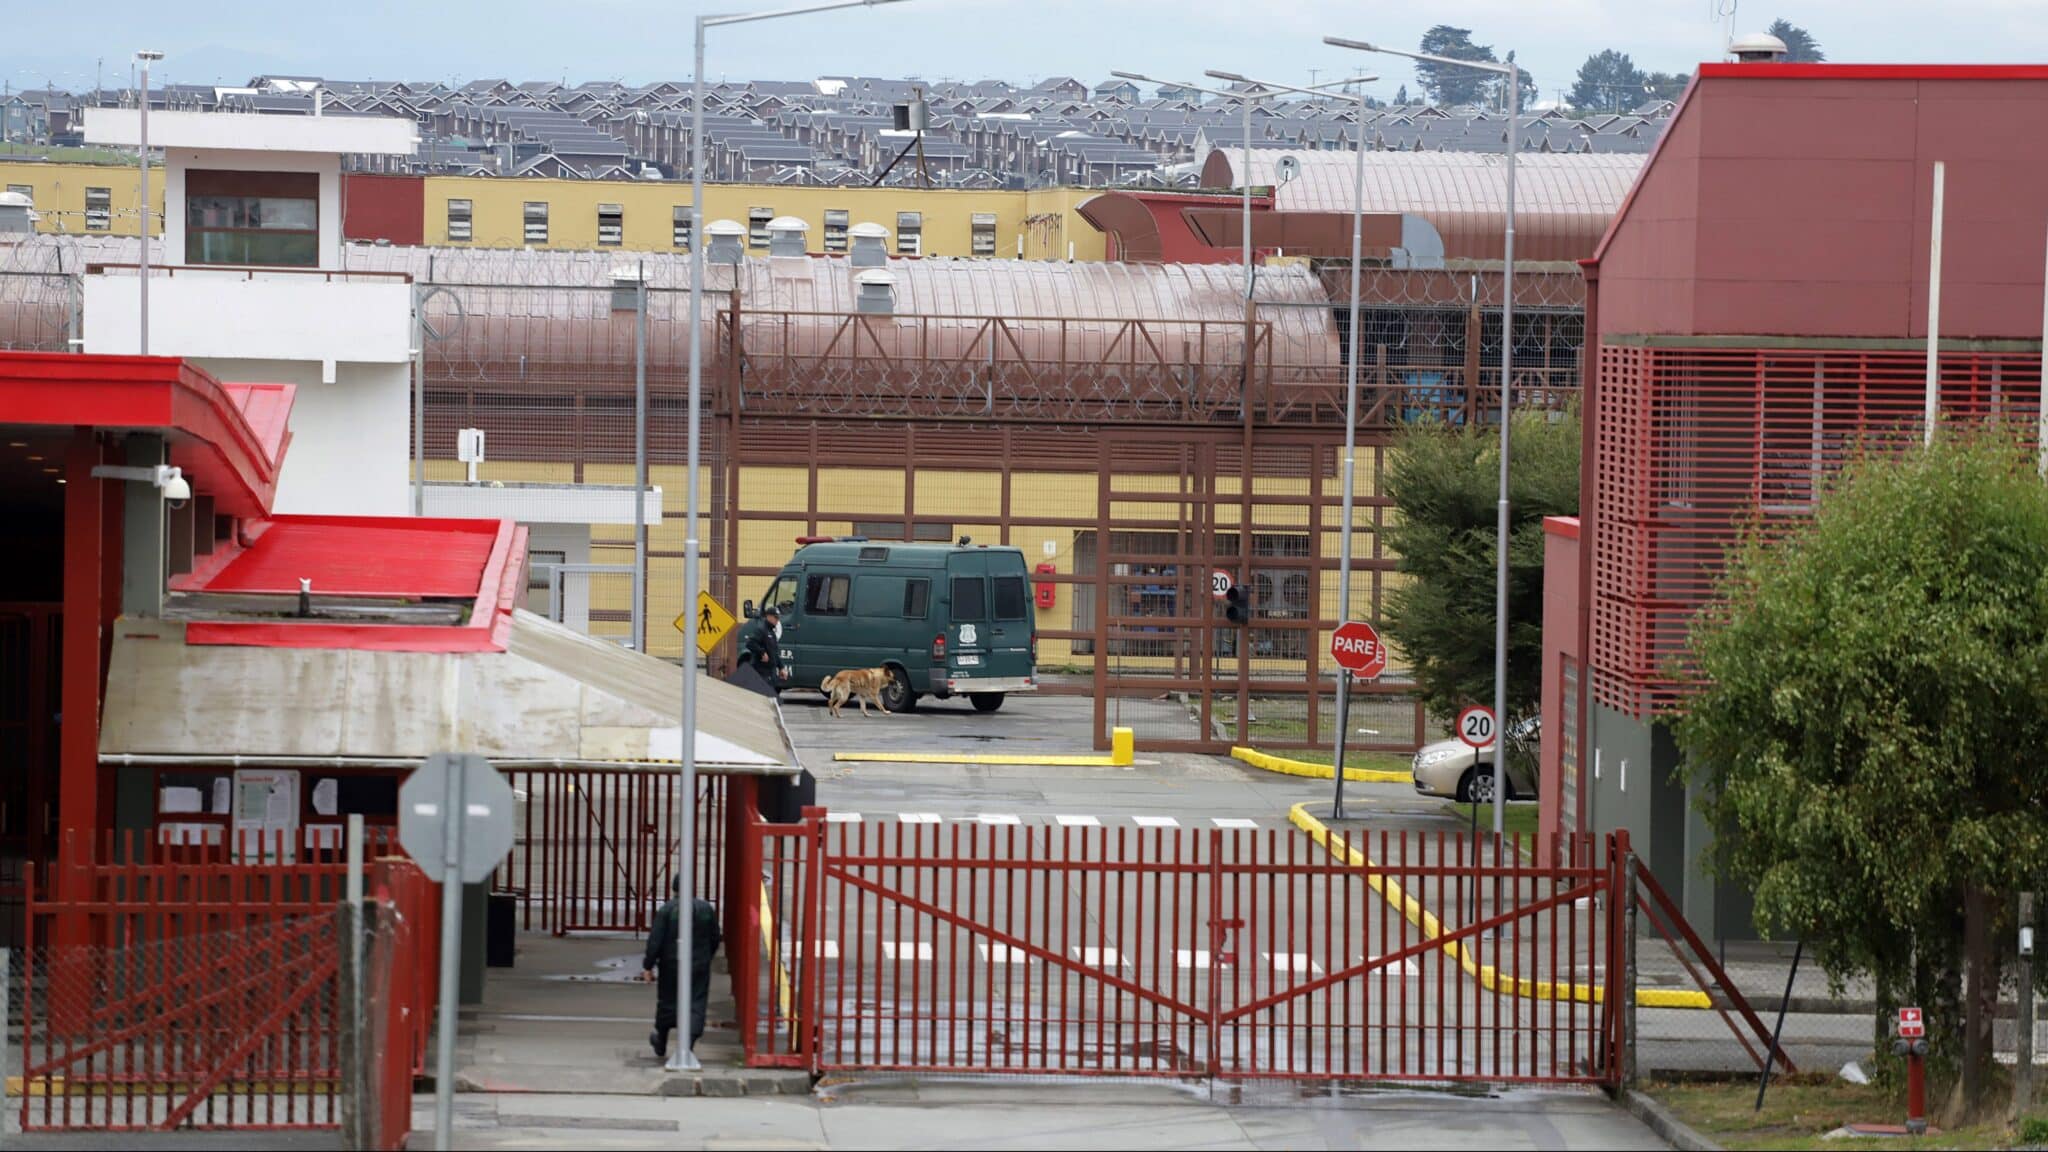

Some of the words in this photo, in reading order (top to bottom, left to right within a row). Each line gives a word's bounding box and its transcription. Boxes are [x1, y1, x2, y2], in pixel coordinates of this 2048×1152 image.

[1212, 576, 1228, 592] 20
[1334, 636, 1375, 656] PARE
[1466, 715, 1490, 737] 20
